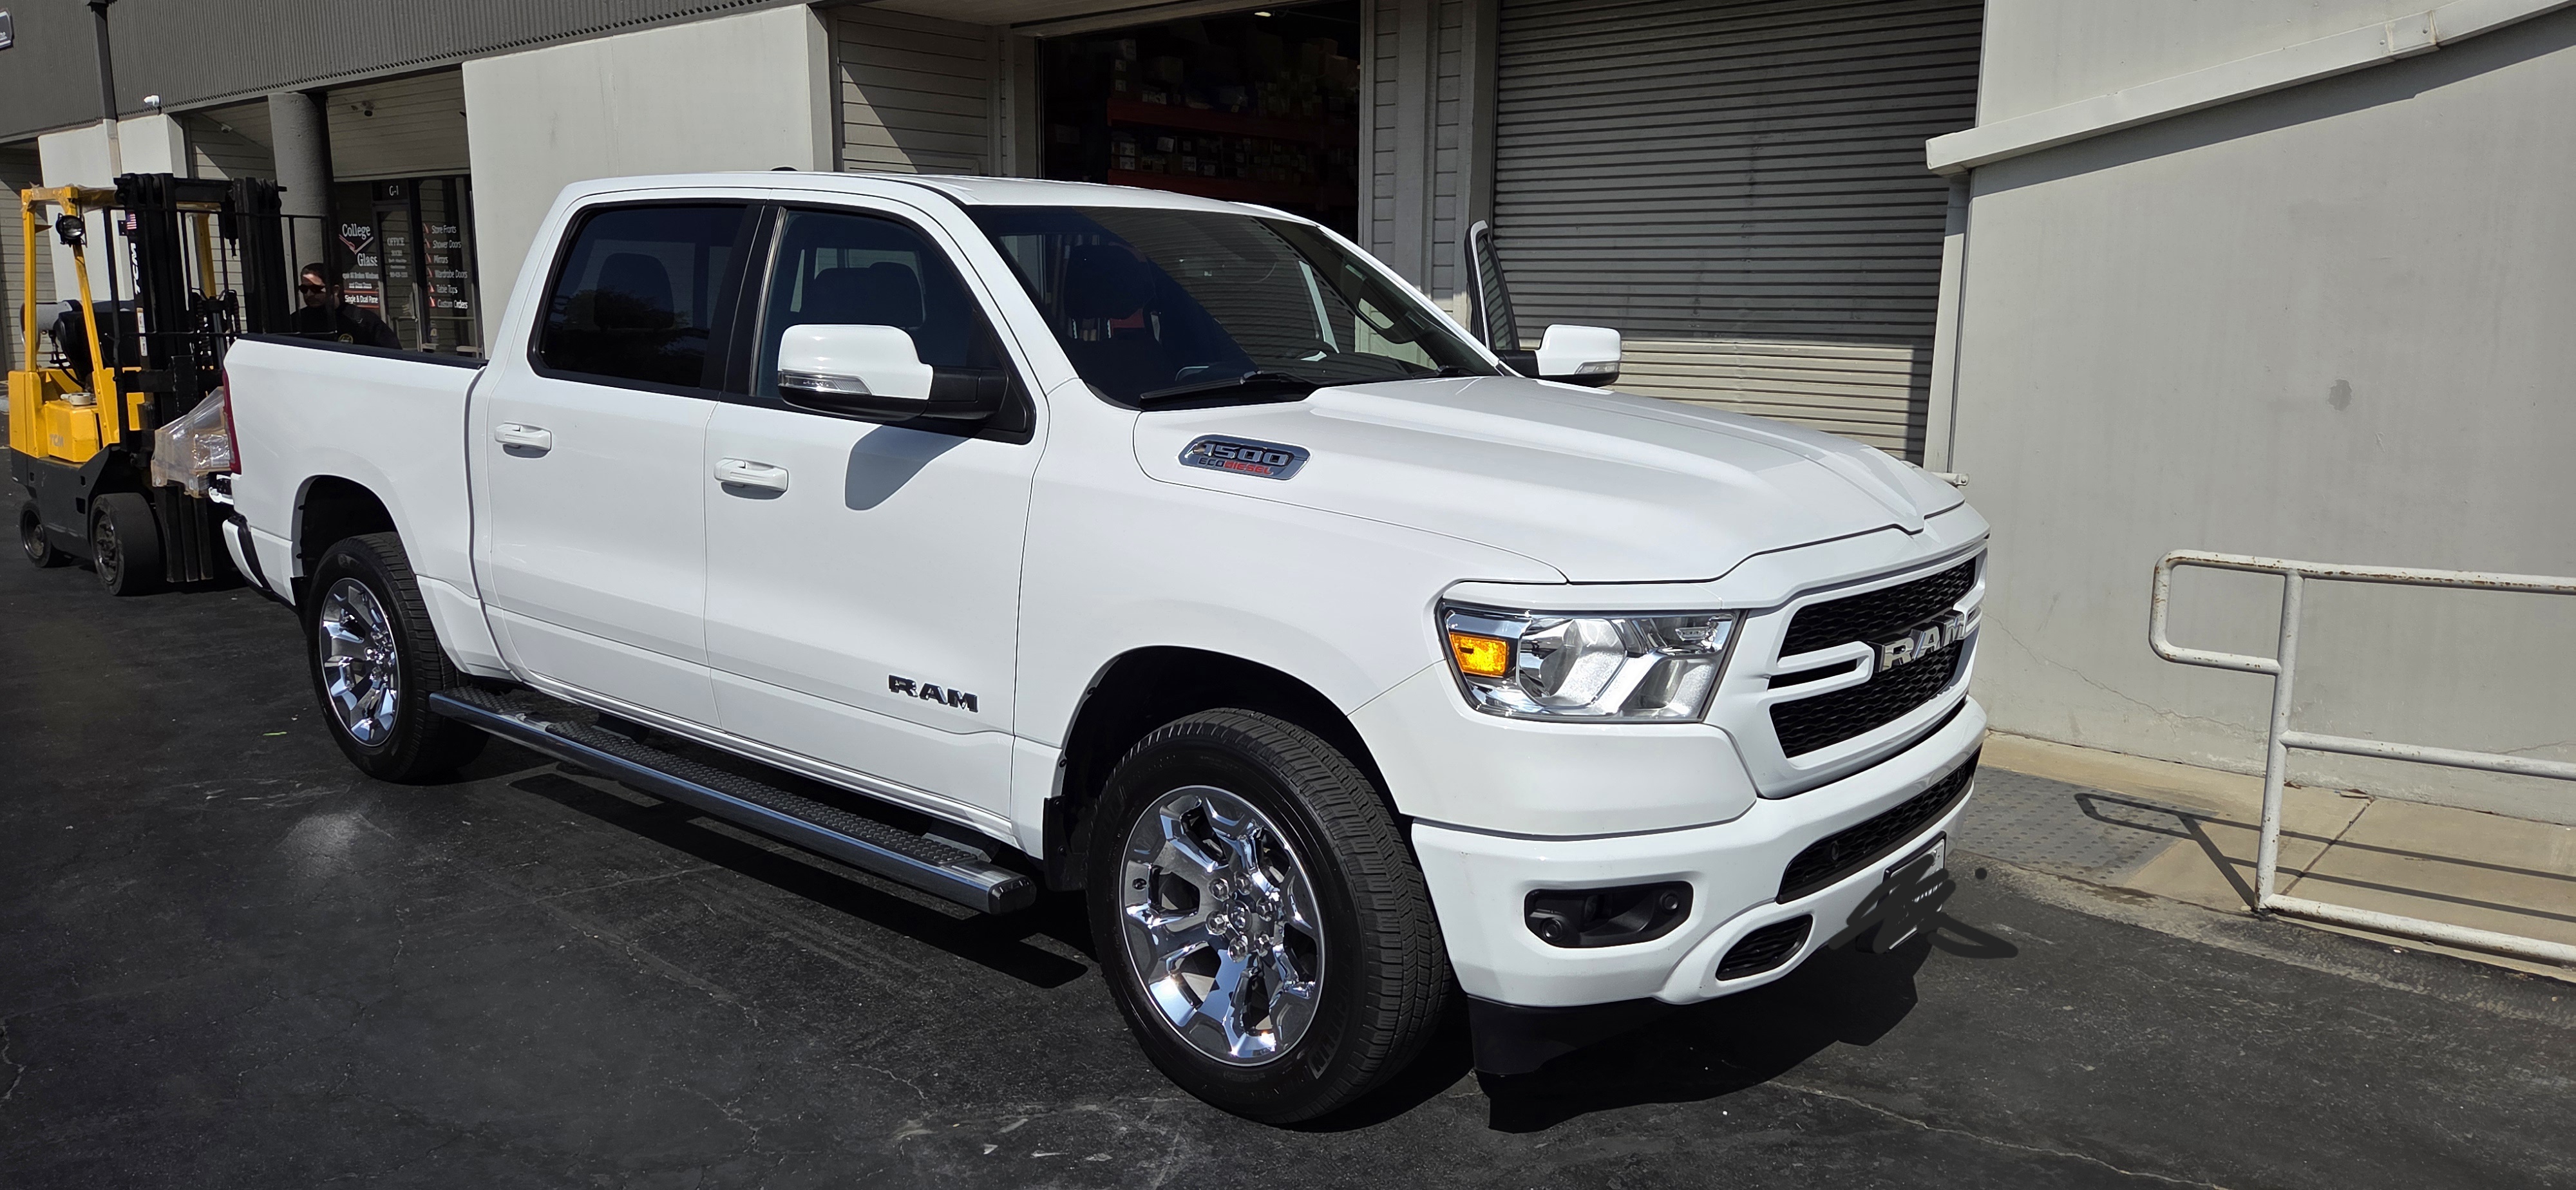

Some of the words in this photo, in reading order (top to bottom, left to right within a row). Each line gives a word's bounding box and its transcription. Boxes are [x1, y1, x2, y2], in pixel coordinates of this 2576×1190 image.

[342, 223, 371, 240] College
[387, 237, 405, 246] OFFICE
[433, 240, 448, 249] Shower
[449, 240, 462, 249] Doors
[357, 252, 378, 267] Glass
[130, 242, 141, 295] TCM
[455, 269, 468, 278] Doors
[436, 284, 448, 294] Table
[345, 294, 356, 305] Single
[360, 295, 368, 303] Dual
[368, 295, 379, 303] Pane
[453, 299, 468, 309] Orders
[1195, 443, 1289, 466] 1500
[1198, 457, 1274, 475] ECODIESEL
[1877, 611, 1965, 672] RAM
[888, 674, 979, 713] RAM
